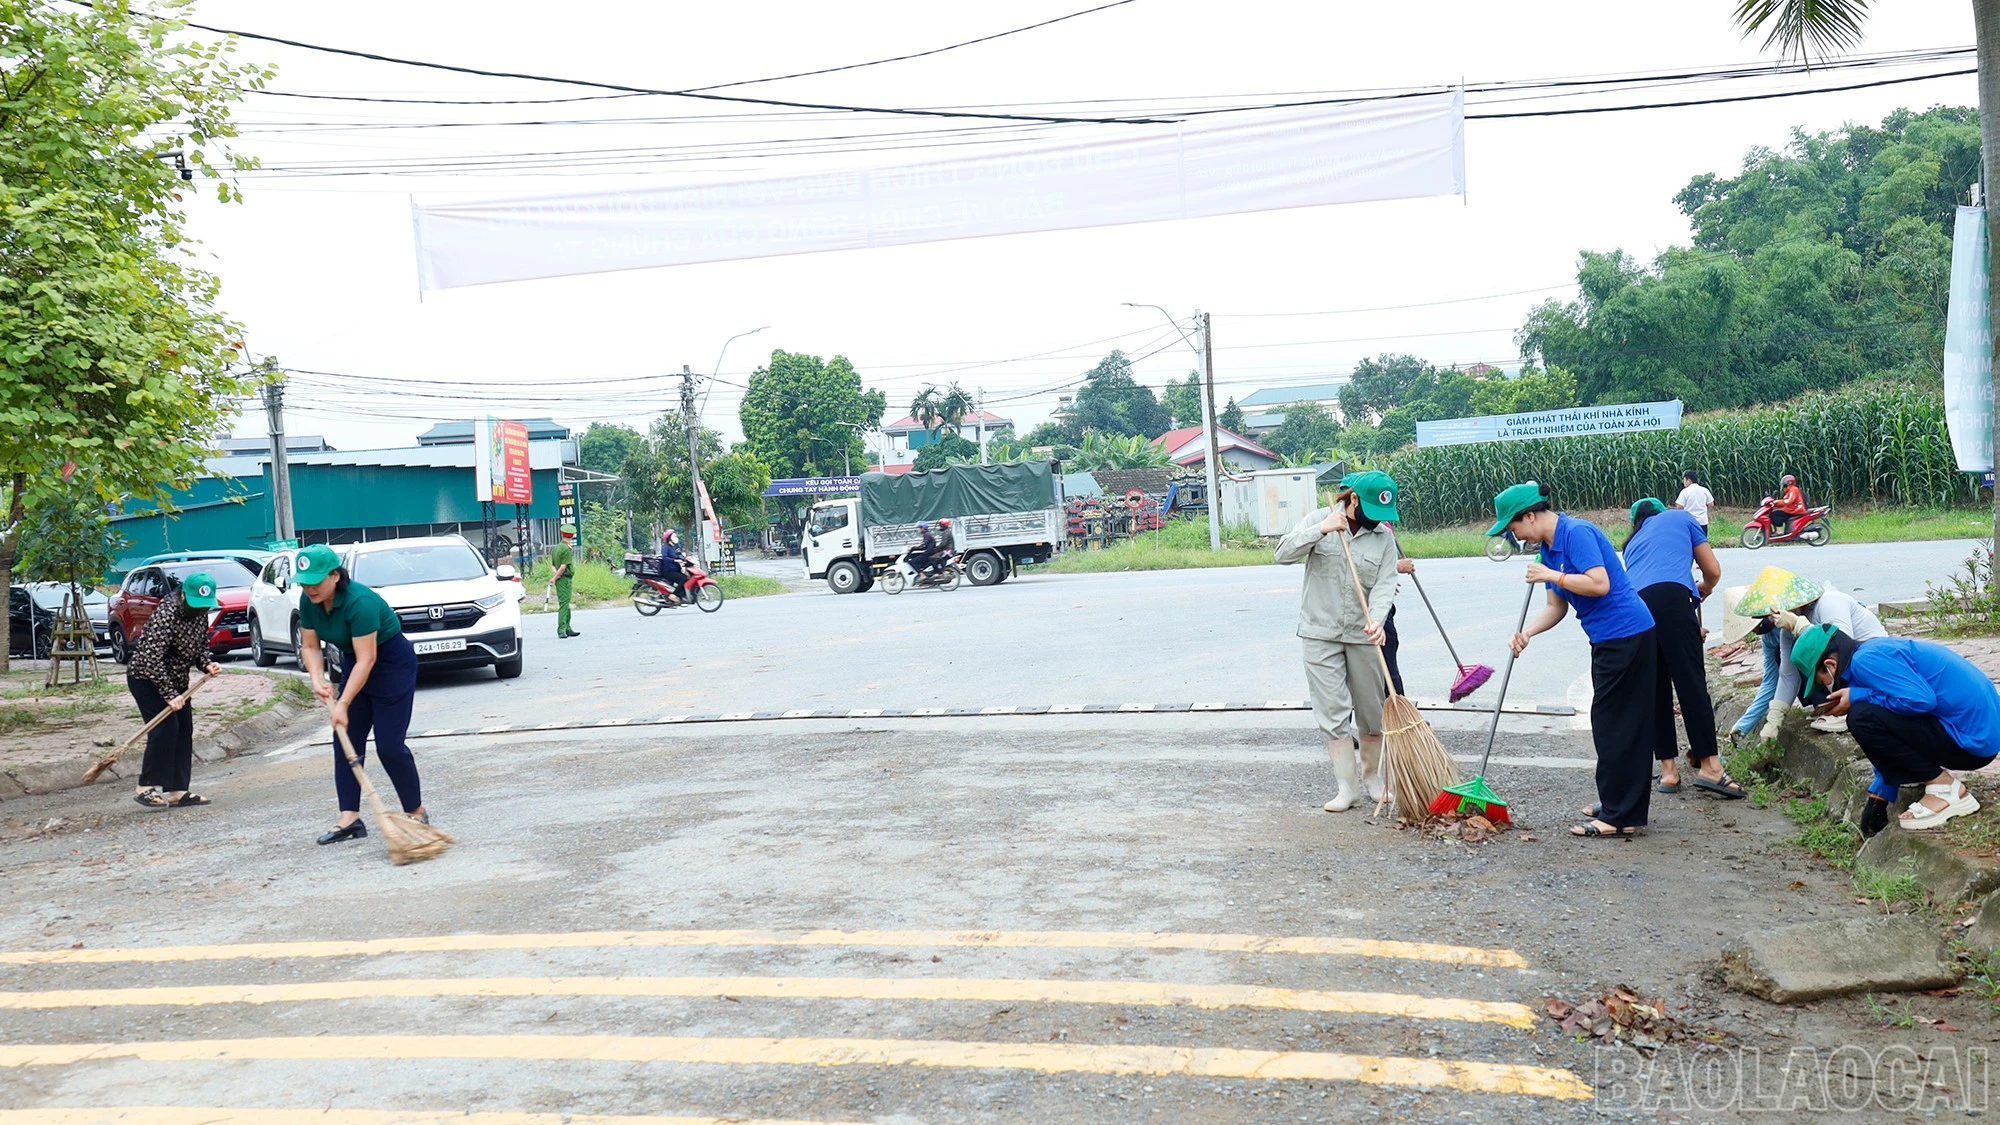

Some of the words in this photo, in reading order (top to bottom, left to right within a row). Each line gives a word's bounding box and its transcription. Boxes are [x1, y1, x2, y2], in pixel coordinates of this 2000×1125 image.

[1497, 427, 1510, 438] LÀ
[1511, 425, 1542, 436] TRÁCH
[1544, 423, 1575, 435] NHIỆM
[1576, 420, 1597, 432] CỦA
[1598, 419, 1626, 430] TOÀN
[1627, 416, 1642, 428] XÃ
[1643, 415, 1662, 427] HỘI
[1506, 416, 1531, 427] GIẢM
[1532, 413, 1557, 425] PHÁT
[1559, 411, 1581, 422] THẢI
[1583, 409, 1600, 421] KHÍ
[1602, 408, 1624, 419] NHÀ
[1625, 406, 1650, 417] KÍNH
[418, 641, 462, 652] 24A-166.29
